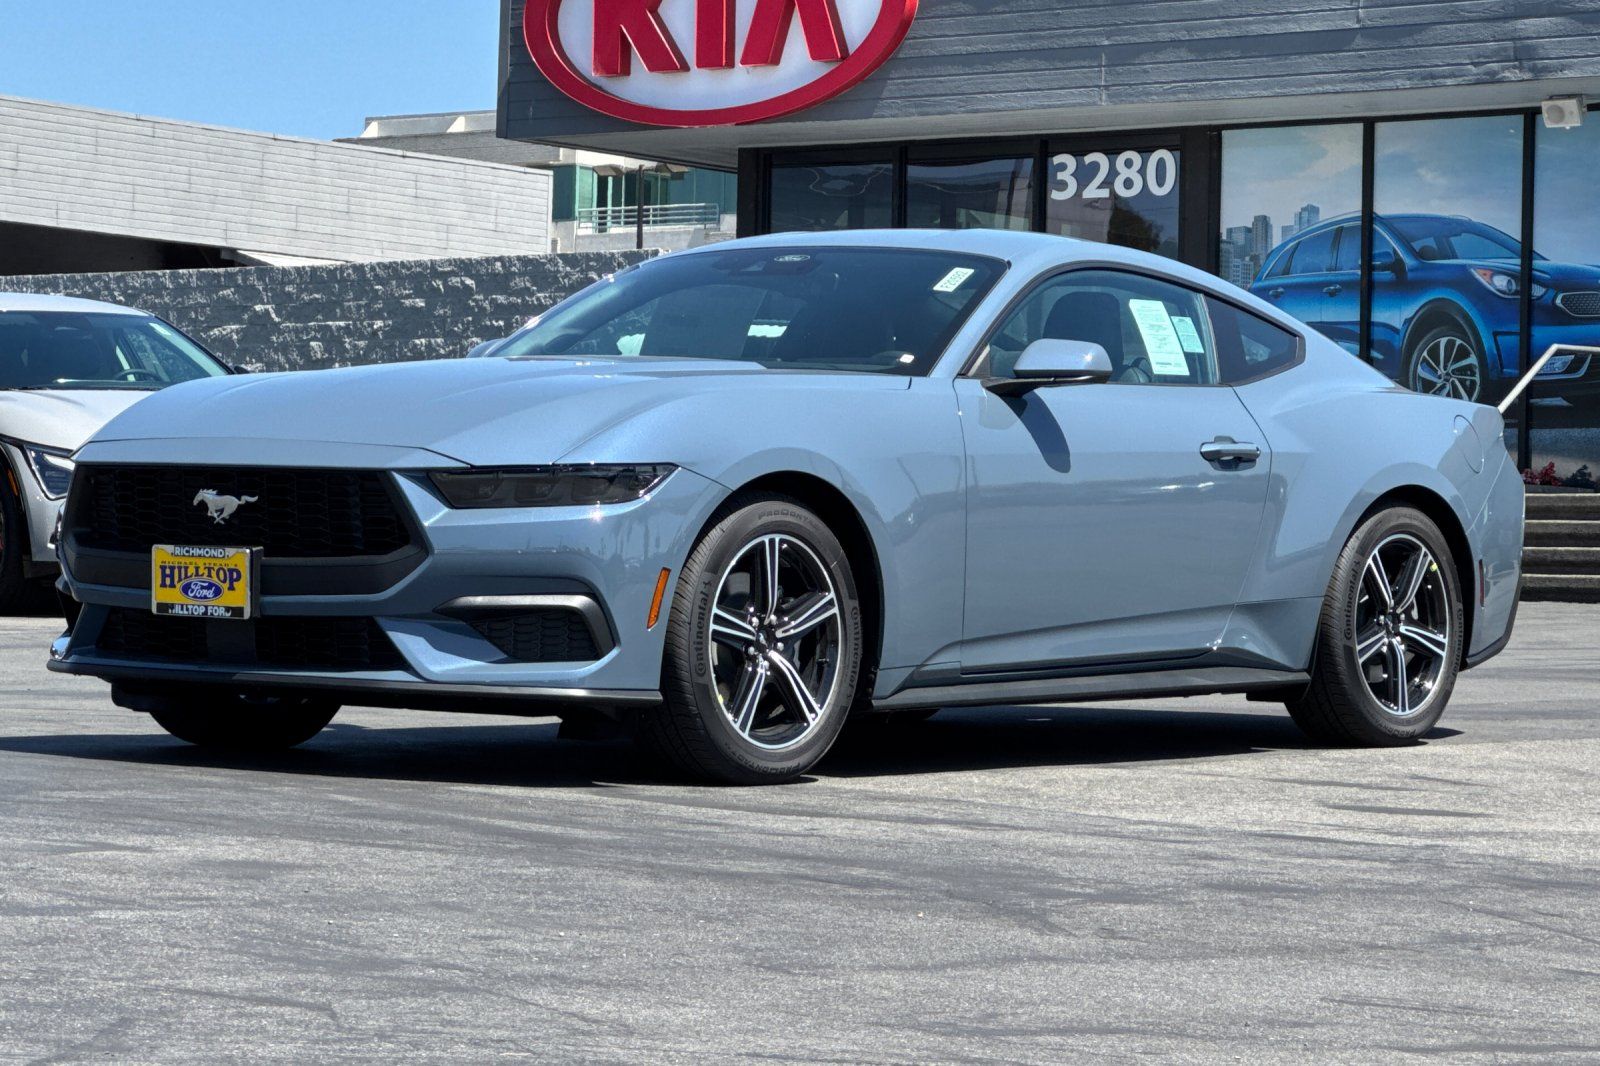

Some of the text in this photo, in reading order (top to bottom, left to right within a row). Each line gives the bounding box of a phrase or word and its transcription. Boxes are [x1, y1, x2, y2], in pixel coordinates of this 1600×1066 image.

[591, 0, 849, 77] KIA
[1050, 148, 1177, 201] 3280
[160, 564, 242, 591] HILLTOP
[175, 547, 225, 557] RICHMOND
[188, 582, 216, 598] Ford
[1343, 568, 1360, 641] Continental
[694, 588, 710, 677] Continental
